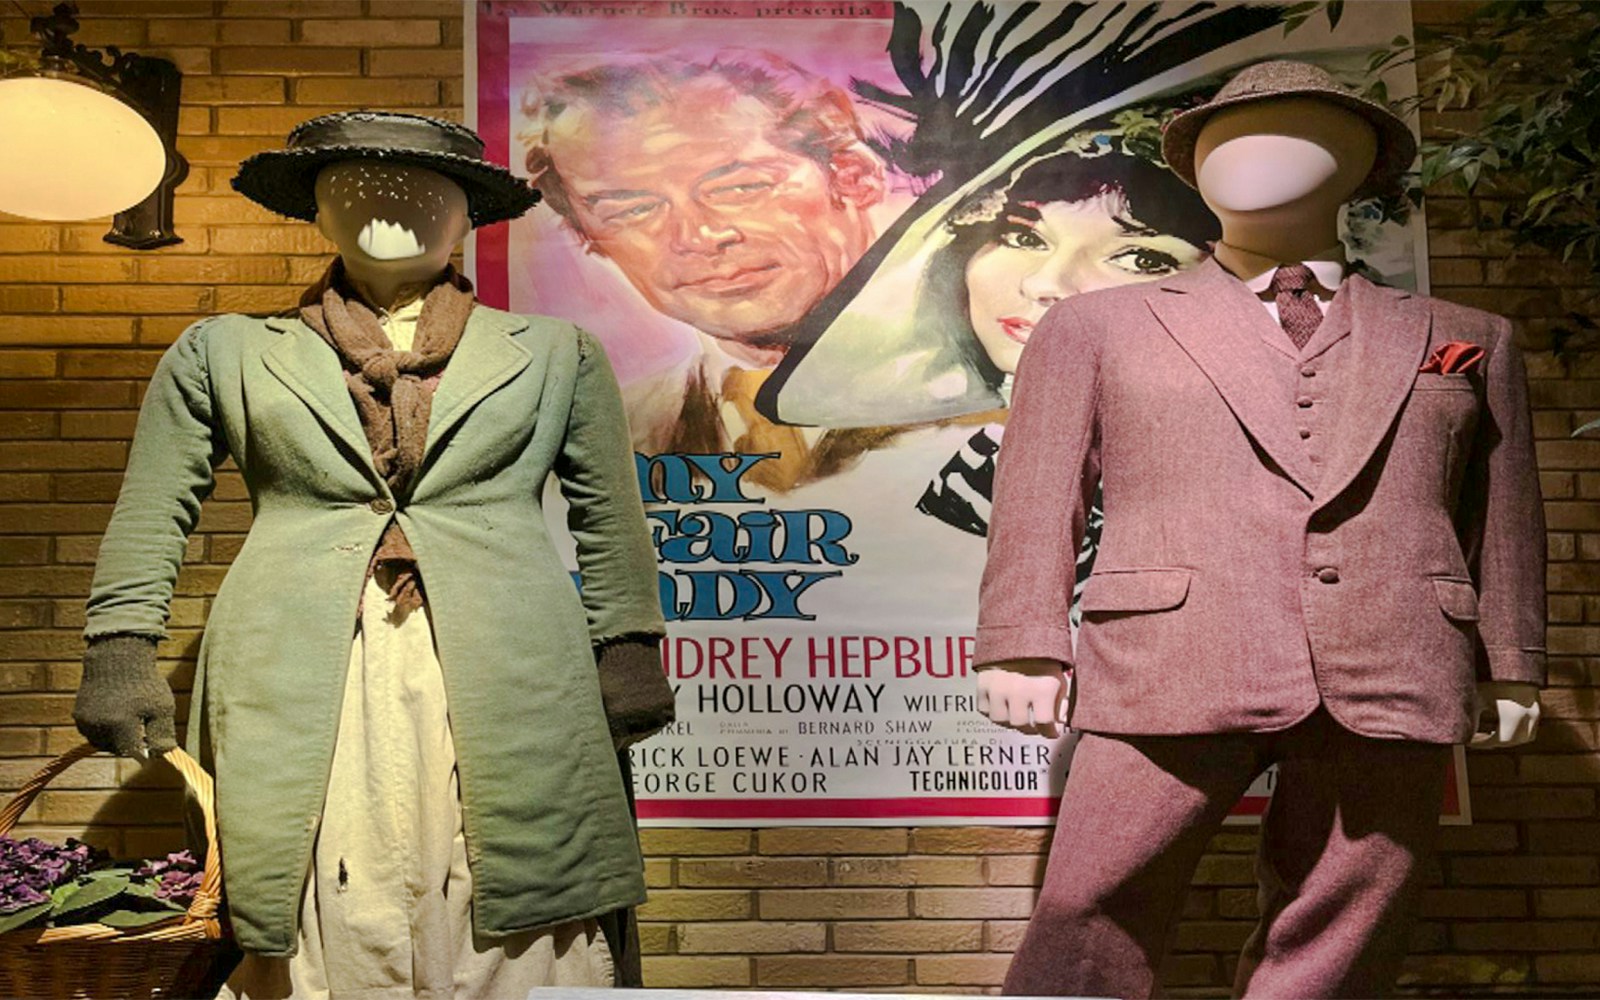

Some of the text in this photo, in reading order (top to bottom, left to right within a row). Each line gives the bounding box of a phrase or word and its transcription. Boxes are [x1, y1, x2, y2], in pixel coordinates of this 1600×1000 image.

[668, 2, 738, 15] Bros.
[754, 3, 873, 17] presenta
[658, 569, 843, 621] DY
[662, 636, 976, 679] DREY HEPBUR
[698, 683, 886, 713] HOLLOWAY
[904, 694, 974, 713] WILFRI
[798, 721, 875, 735] BERNARD
[885, 720, 933, 735] SHAW
[698, 746, 789, 768] LOEWE
[811, 746, 879, 768] ALAN
[892, 745, 934, 767] JAY
[949, 745, 1051, 767] LERNER
[631, 772, 828, 793] EORGE CUKOR
[909, 770, 1038, 792] TECHNICOLOR
